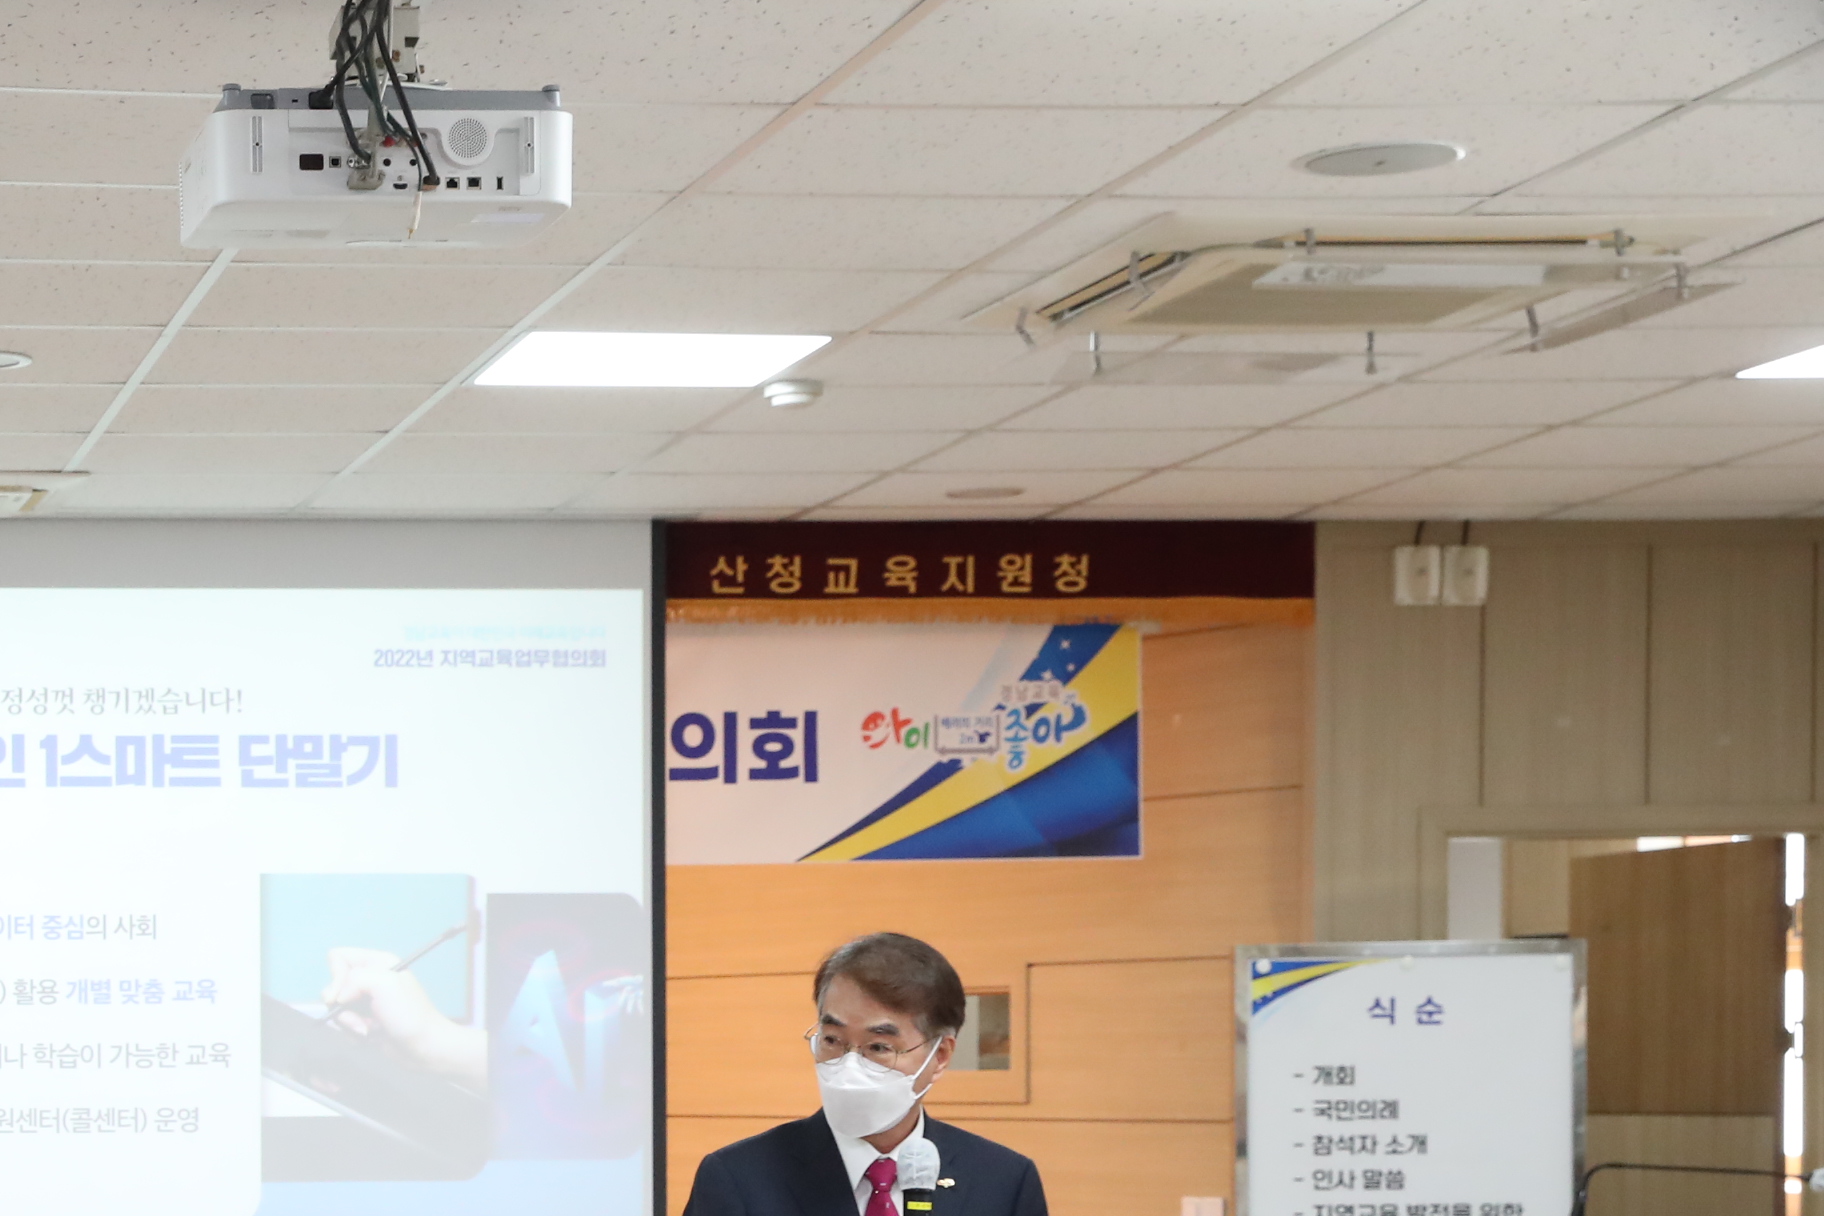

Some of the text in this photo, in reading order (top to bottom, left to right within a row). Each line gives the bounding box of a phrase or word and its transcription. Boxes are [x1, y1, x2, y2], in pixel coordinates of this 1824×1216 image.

[374, 649, 433, 667] 2022년
[1, 687, 74, 715] 정성껏
[84, 688, 242, 715] 챙기겠습니다!
[669, 710, 818, 784] 의회
[39, 734, 221, 788] 1스마트
[238, 734, 398, 788] 단말기
[42, 914, 106, 940] 중심의
[114, 914, 156, 940] 사회
[13, 979, 59, 1005] 활용
[66, 979, 111, 1004] 개별
[119, 979, 165, 1004] 맞춤
[172, 979, 217, 1004] 교육
[33, 1043, 101, 1069] 학습이
[110, 1043, 179, 1068] 가능한
[185, 1043, 231, 1068] 교육
[1314, 1066, 1355, 1085] 개회
[154, 1107, 199, 1133] 운영
[1314, 1100, 1399, 1121] 국민의례
[1313, 1134, 1427, 1156] 참석자 소개
[1312, 1169, 1405, 1191] 인사 말씀
